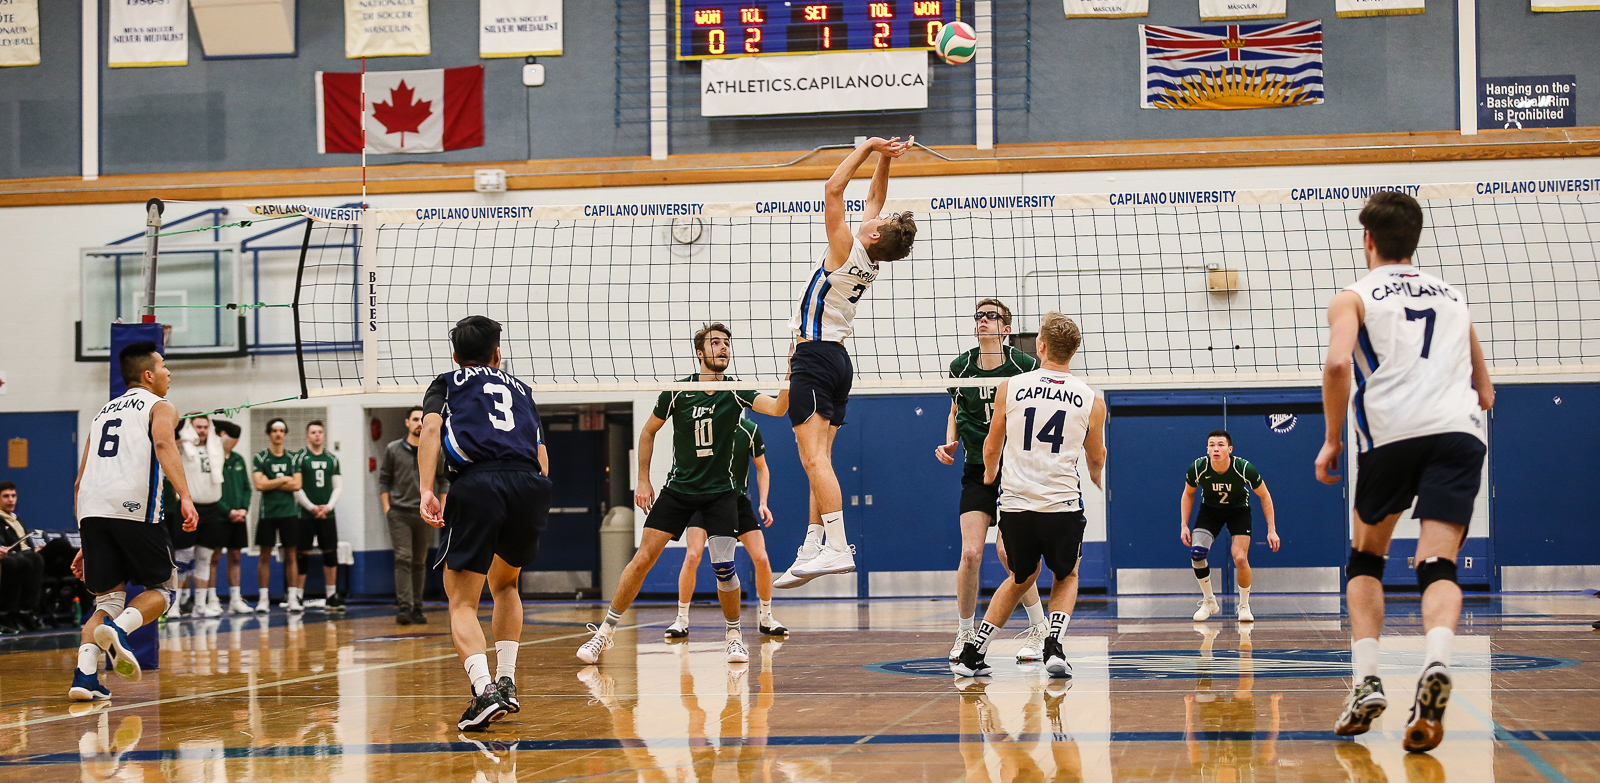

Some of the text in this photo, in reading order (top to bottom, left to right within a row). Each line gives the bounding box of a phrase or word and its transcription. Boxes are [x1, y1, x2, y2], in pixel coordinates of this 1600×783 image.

[377, 11, 413, 19] SOCCER
[695, 1, 940, 24] WON TOL SET TOL WON
[484, 22, 558, 33] SILVER MEDALIST
[113, 34, 183, 43] SILVER MEDALIST
[708, 29, 725, 54] 0
[745, 27, 761, 53] 2
[823, 26, 830, 48] 1
[873, 22, 890, 48] 2
[705, 73, 924, 94] ATHLETICS.CAPILANOU.CA
[1486, 82, 1570, 96] Hanging on the
[1549, 95, 1570, 106] Rim
[1494, 108, 1564, 121] is Prohibited
[1291, 187, 1349, 201] CAPILANO
[1476, 181, 1536, 195] CAPILANO
[930, 195, 1056, 210] CAPILANO UNIVERSITY
[1109, 191, 1236, 205] CAPILANO UNIVERSITY
[254, 204, 307, 215] CAPILANO
[416, 206, 533, 220] CAPILANO UNIVERSITY
[584, 203, 704, 217] CAPILANO UNIVERSITY
[755, 201, 811, 213] CAPILANO
[1371, 282, 1458, 302] CAPILANO
[369, 271, 377, 331] BLUES
[1404, 307, 1436, 359] 7
[453, 366, 526, 396] CAPILANO
[979, 387, 996, 399] UF
[1015, 387, 1083, 408] CAPILANO
[483, 382, 515, 432] 3
[694, 418, 713, 447] 10
[1023, 407, 1067, 453] 14
[97, 418, 122, 457] 6
[315, 469, 325, 487] 9
[1211, 483, 1232, 491] UFV
[1218, 491, 1230, 504] 2
